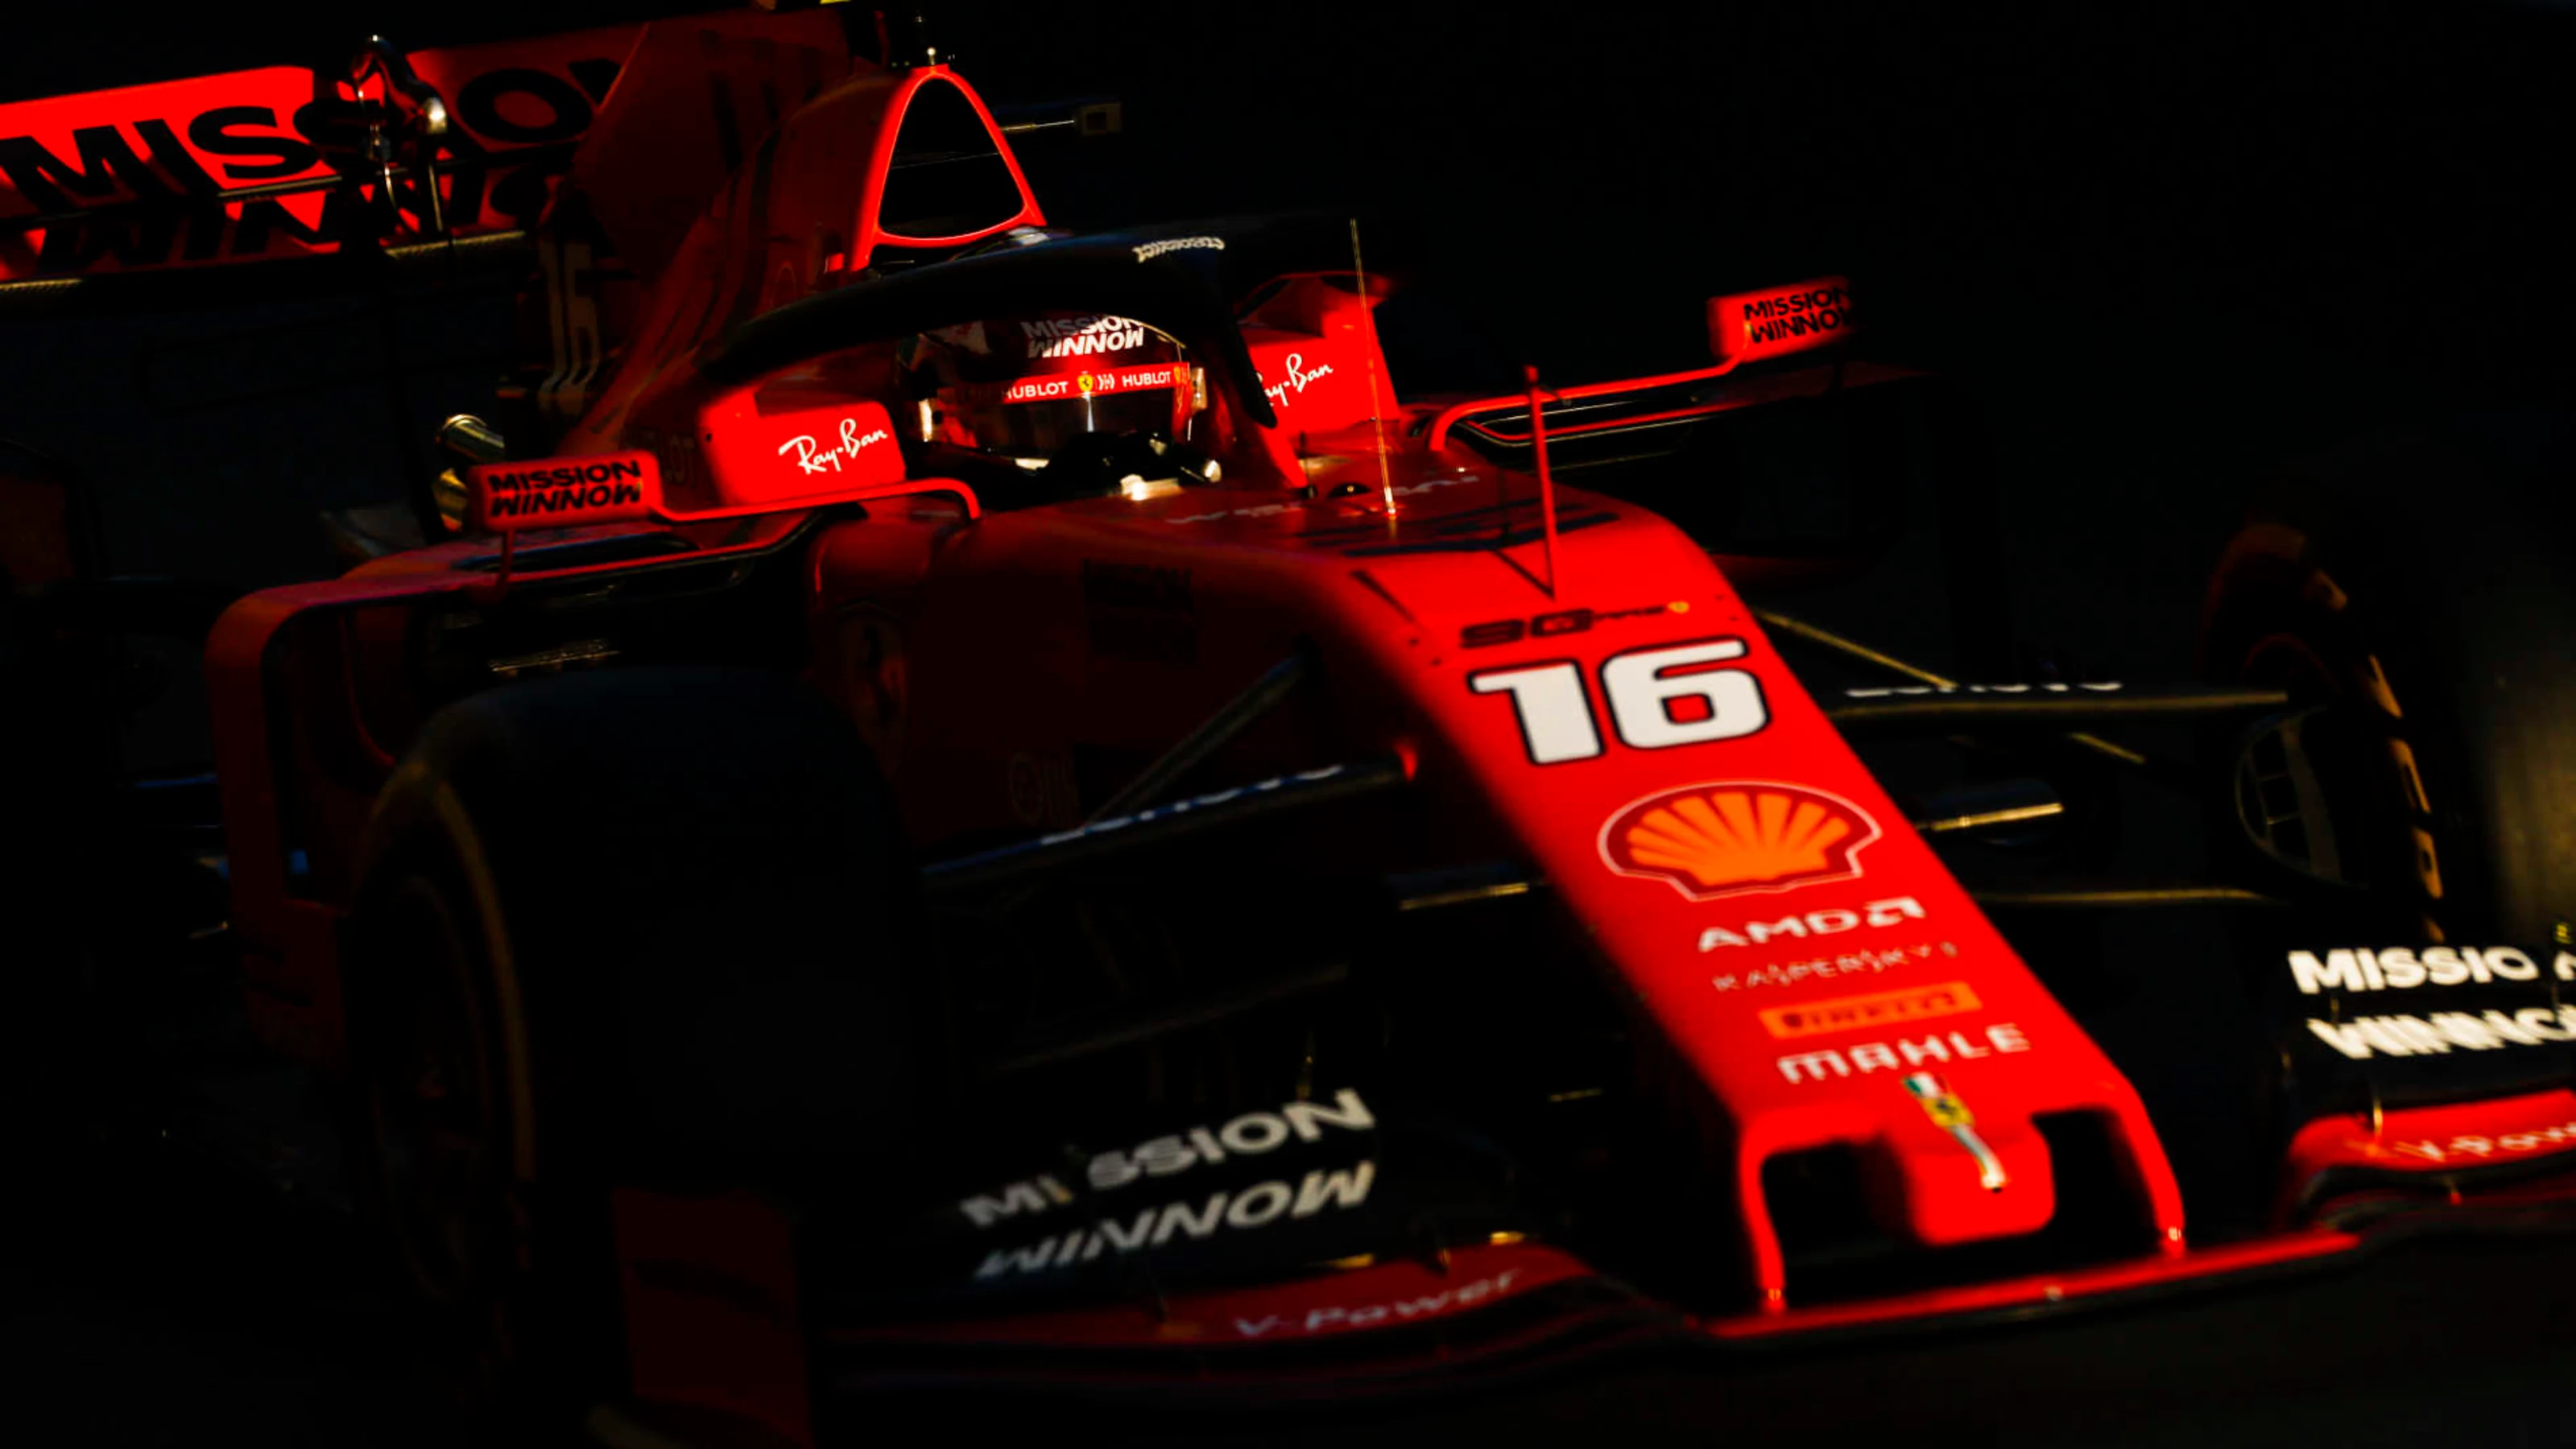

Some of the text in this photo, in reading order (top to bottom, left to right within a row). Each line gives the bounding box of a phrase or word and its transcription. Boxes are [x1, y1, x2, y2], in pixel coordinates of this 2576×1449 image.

[1028, 325, 1144, 359] WINNOW
[1122, 371, 1172, 387] HUBLOT
[778, 418, 888, 475] Ray-Ban
[488, 460, 641, 491] MISSION
[491, 483, 641, 517] WINNOW
[1469, 635, 1770, 766] 16
[1776, 1021, 2032, 1086] MAHLE
[958, 1085, 1378, 1230] MISSION
[971, 1158, 1378, 1282] WINNOW
